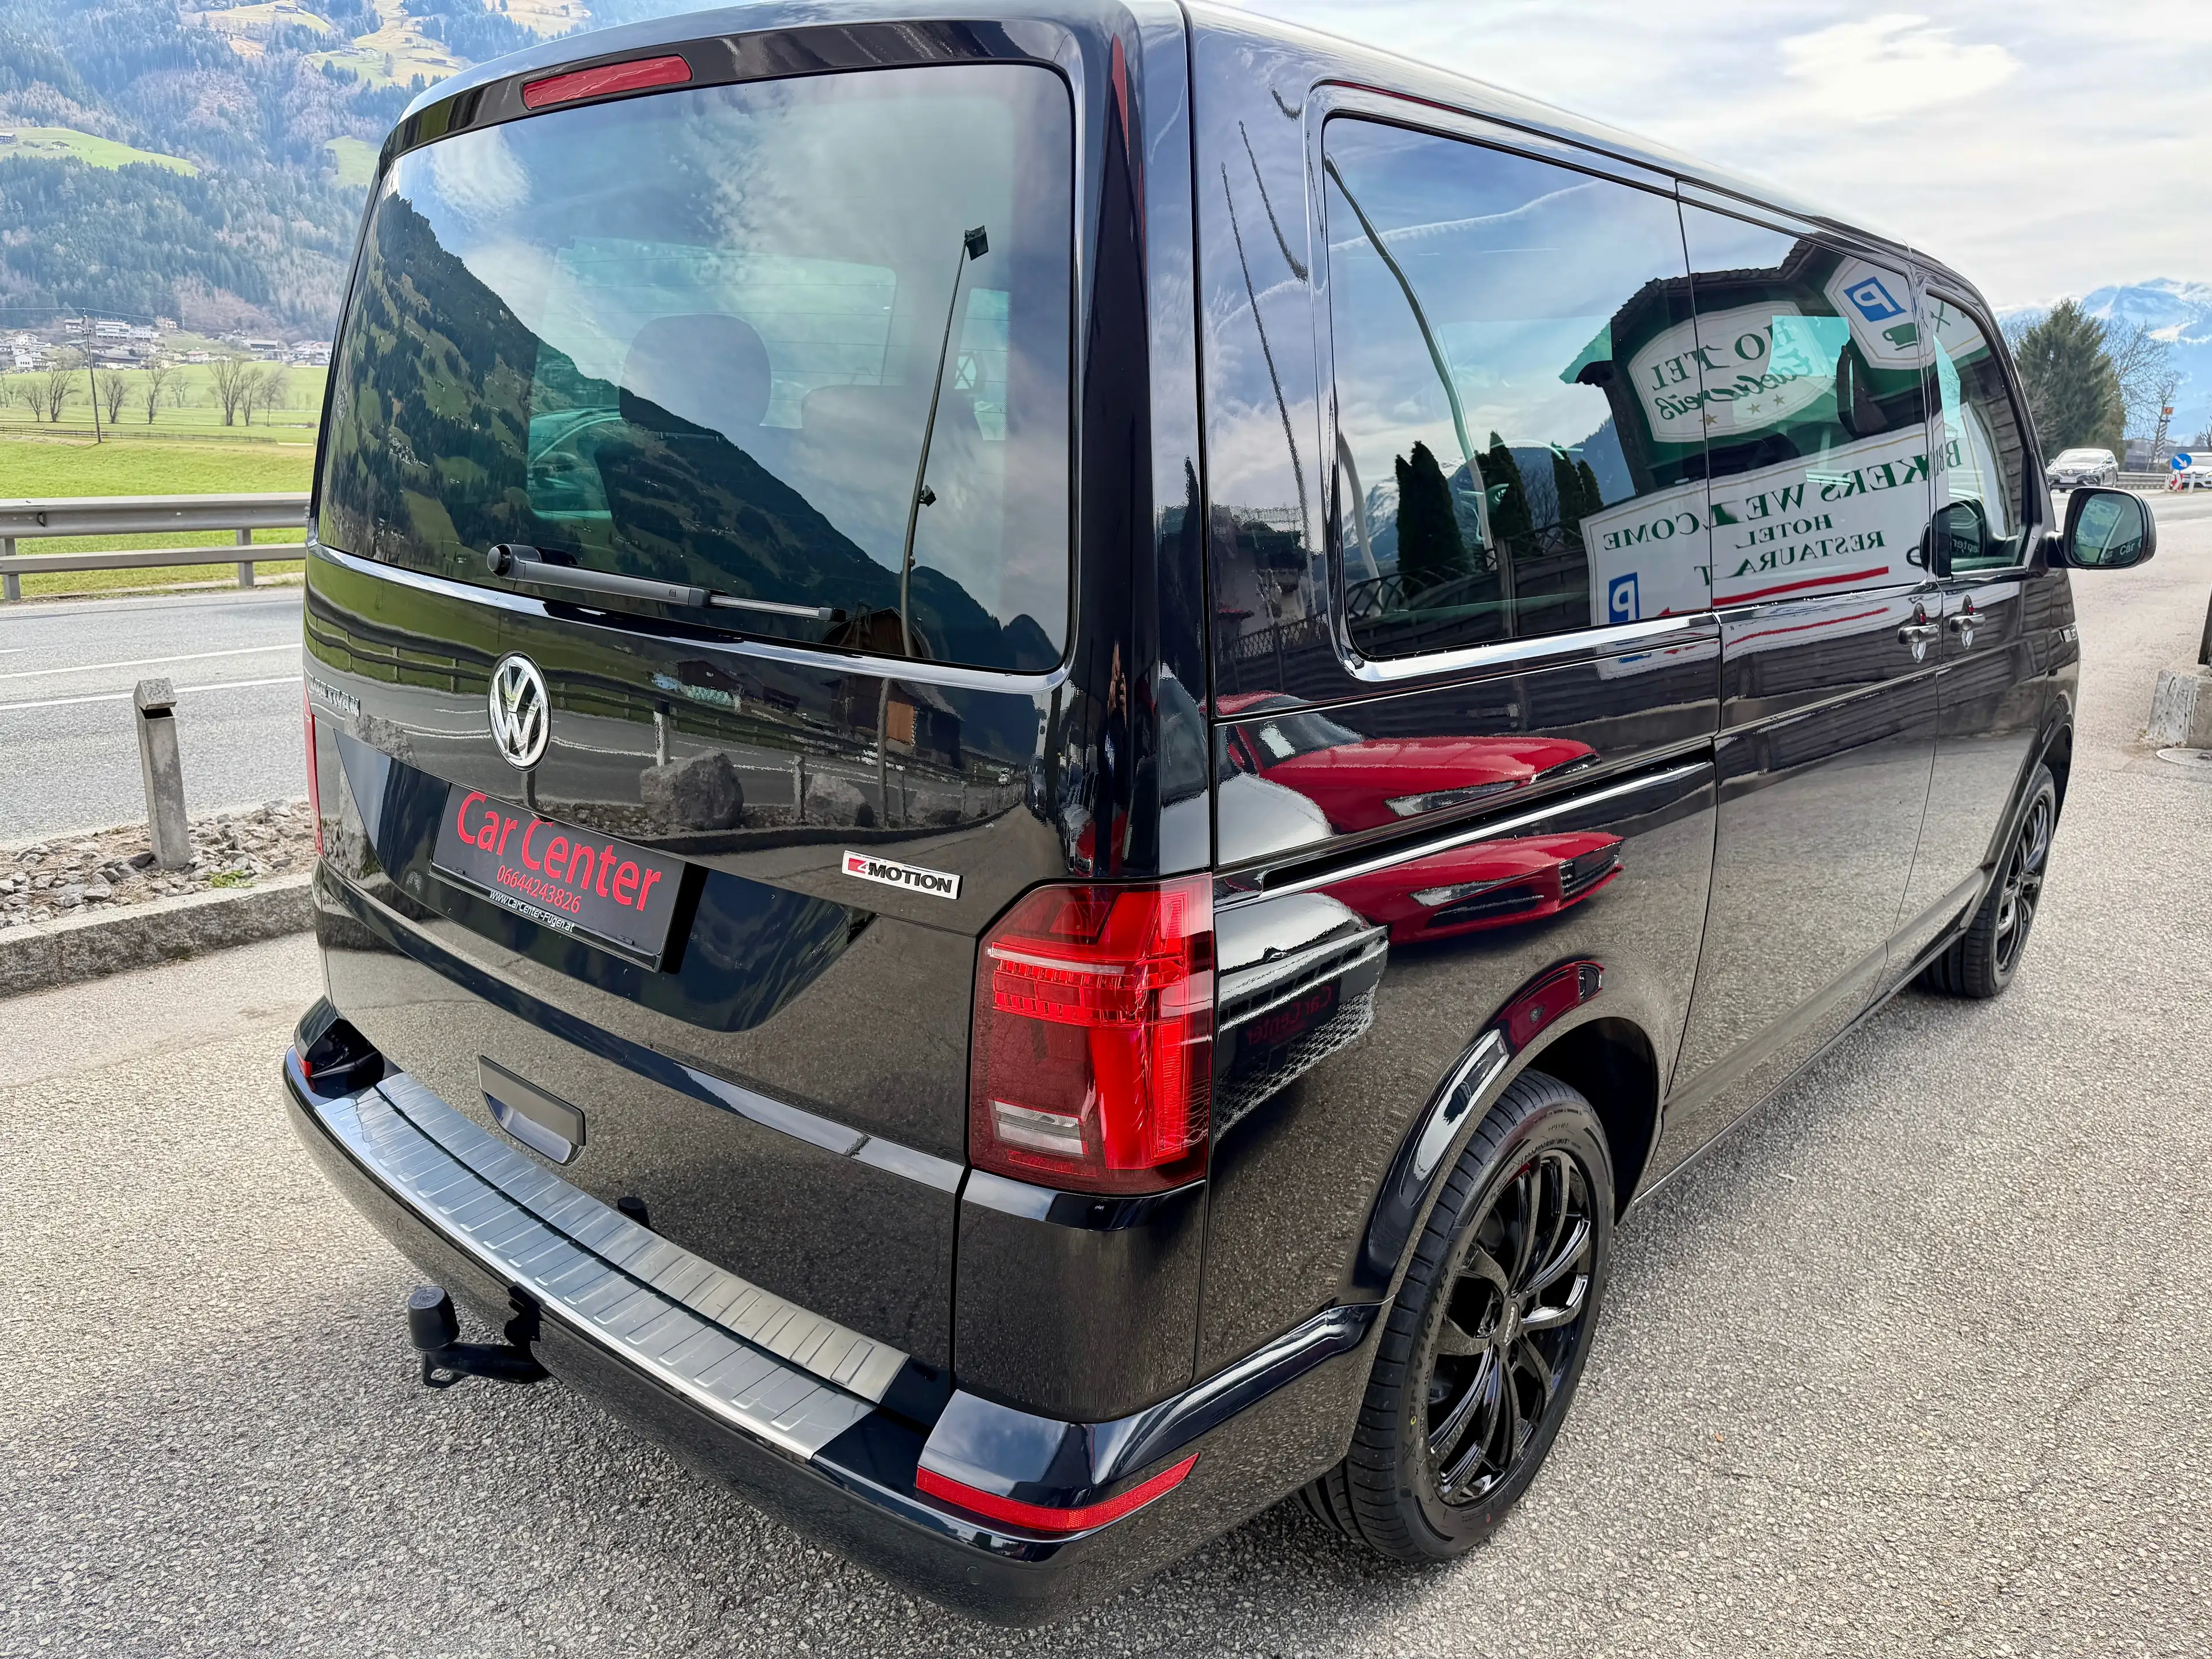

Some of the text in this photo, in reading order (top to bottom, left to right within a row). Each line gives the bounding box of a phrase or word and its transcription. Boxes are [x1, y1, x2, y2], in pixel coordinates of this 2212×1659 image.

[2120, 543, 2136, 556] Car
[457, 791, 661, 911] Car Center
[497, 865, 581, 914] 06644243826
[848, 858, 952, 893] 4MOTION
